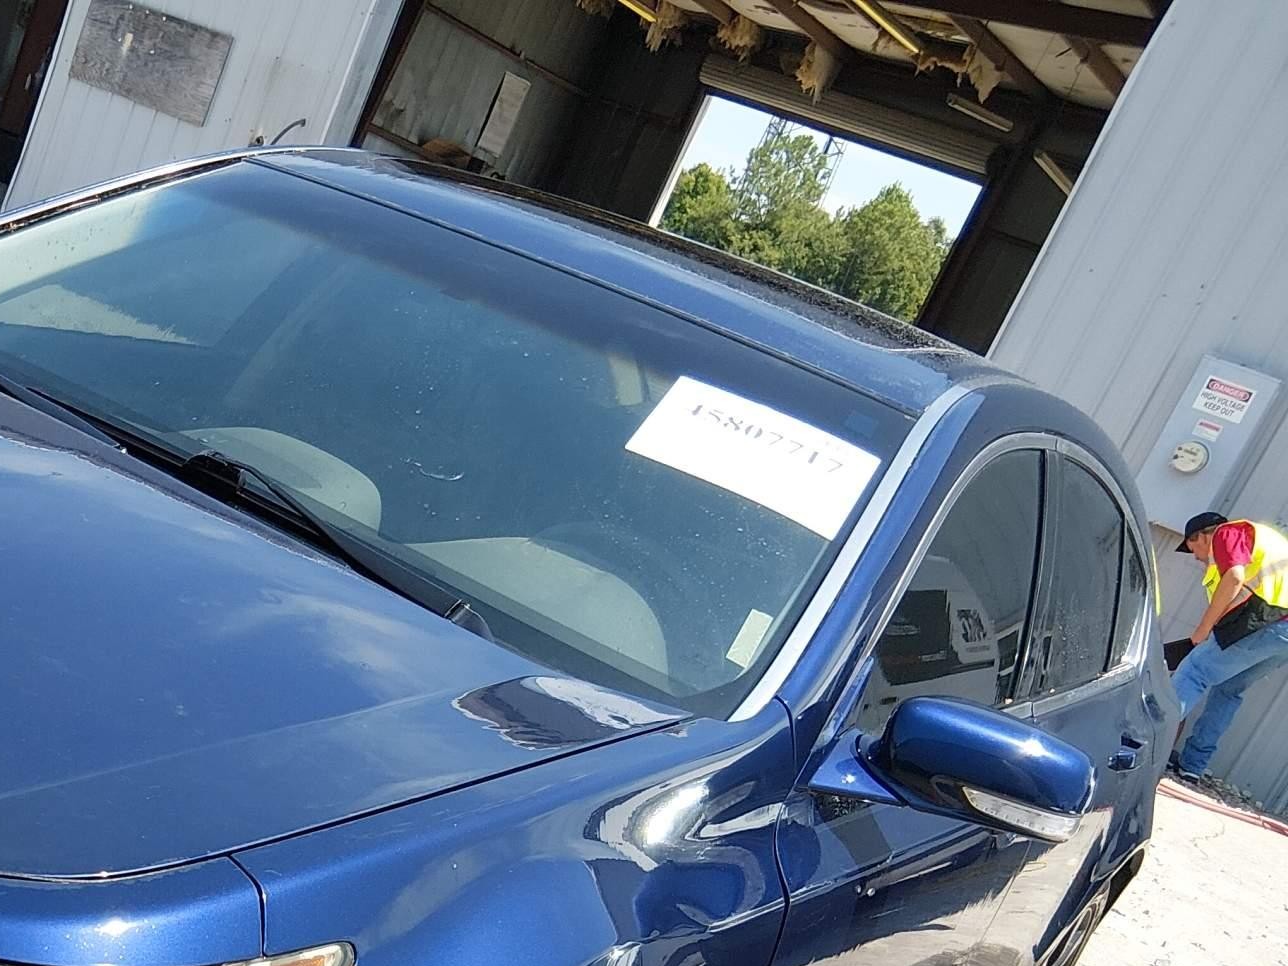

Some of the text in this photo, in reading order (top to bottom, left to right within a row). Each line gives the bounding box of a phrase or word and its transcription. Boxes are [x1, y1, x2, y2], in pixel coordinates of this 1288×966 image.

[1212, 381, 1244, 400] DANGER
[1201, 392, 1246, 412] HIGH VOLTAGE
[1204, 402, 1235, 417] KEEP OUT
